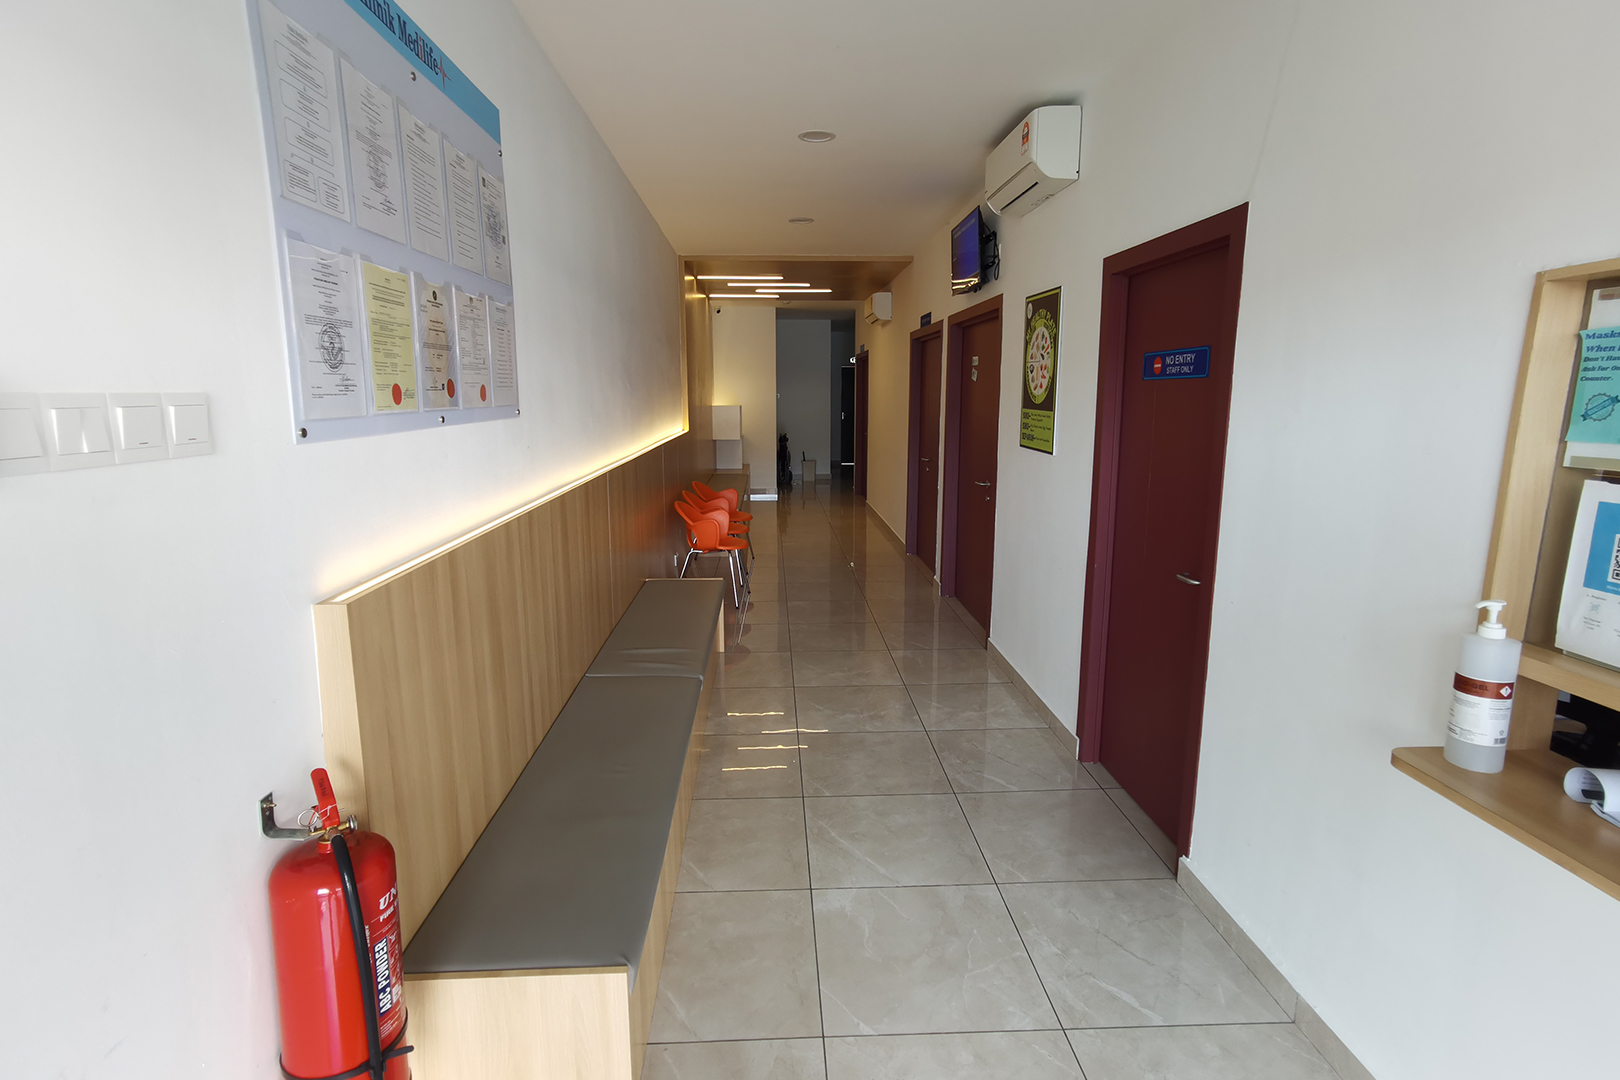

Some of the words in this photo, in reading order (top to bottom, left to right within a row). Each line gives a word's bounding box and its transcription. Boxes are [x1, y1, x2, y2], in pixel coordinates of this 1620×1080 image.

[396, 12, 439, 76] Medilife
[1165, 355, 1175, 365] NO
[1175, 353, 1196, 364] ENTRY
[1166, 366, 1180, 374] STAFF
[1180, 365, 1194, 373] ONLY
[374, 938, 390, 990] POWDER
[378, 986, 393, 1014] ABC
